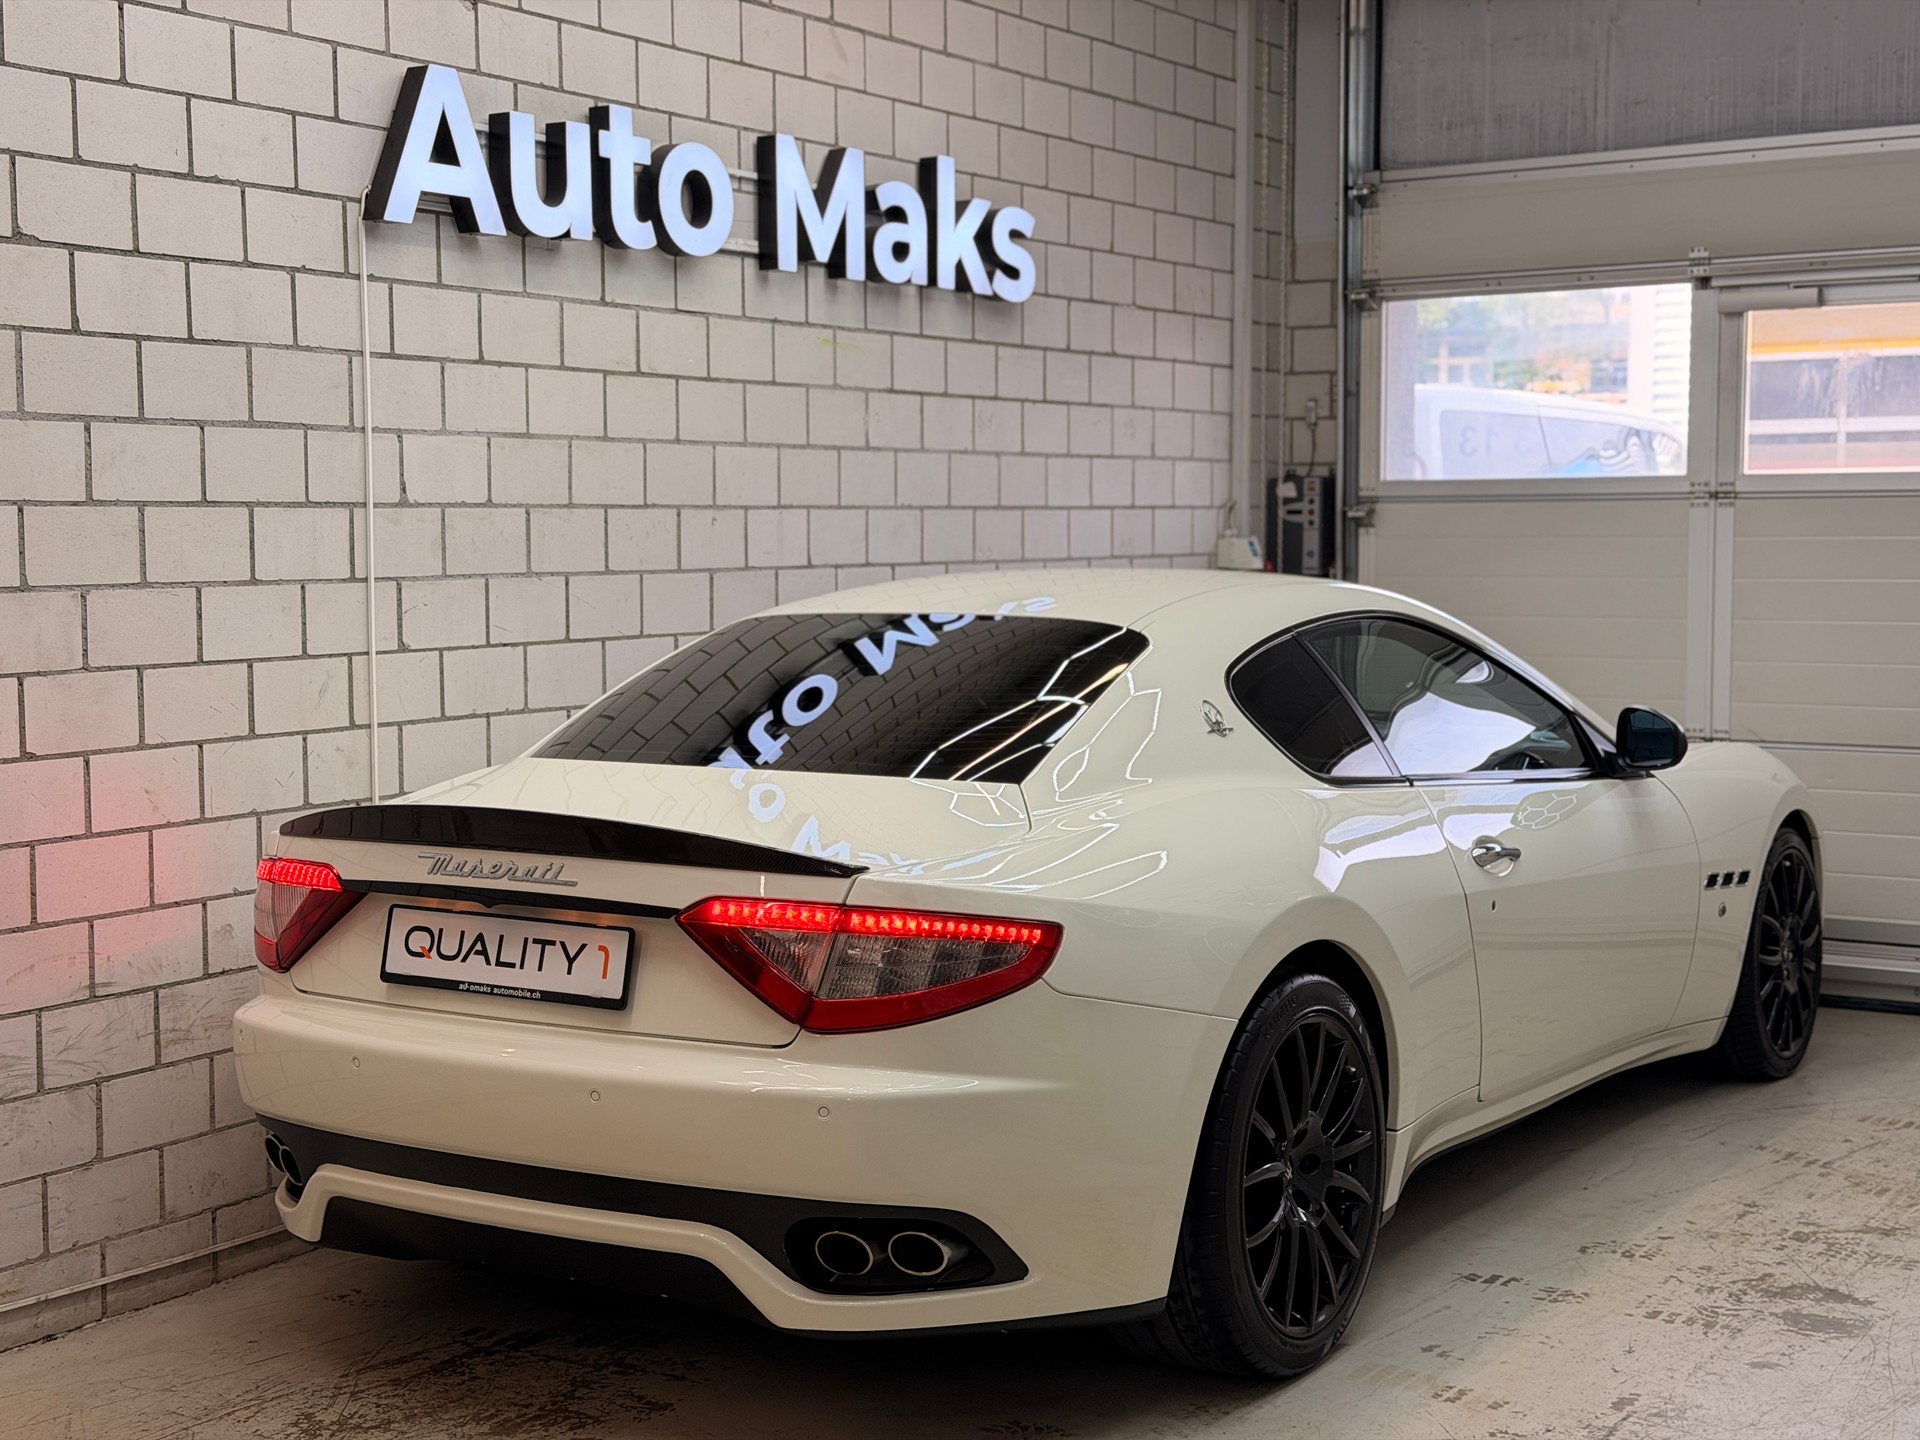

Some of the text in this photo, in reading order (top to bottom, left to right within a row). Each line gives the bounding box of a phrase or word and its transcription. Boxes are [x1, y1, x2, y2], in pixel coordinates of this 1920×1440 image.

[378, 63, 1037, 303] Auto Maks
[417, 852, 579, 887] Maserati
[404, 925, 589, 976] QUALITY
[493, 986, 542, 1000] automobile.ch
